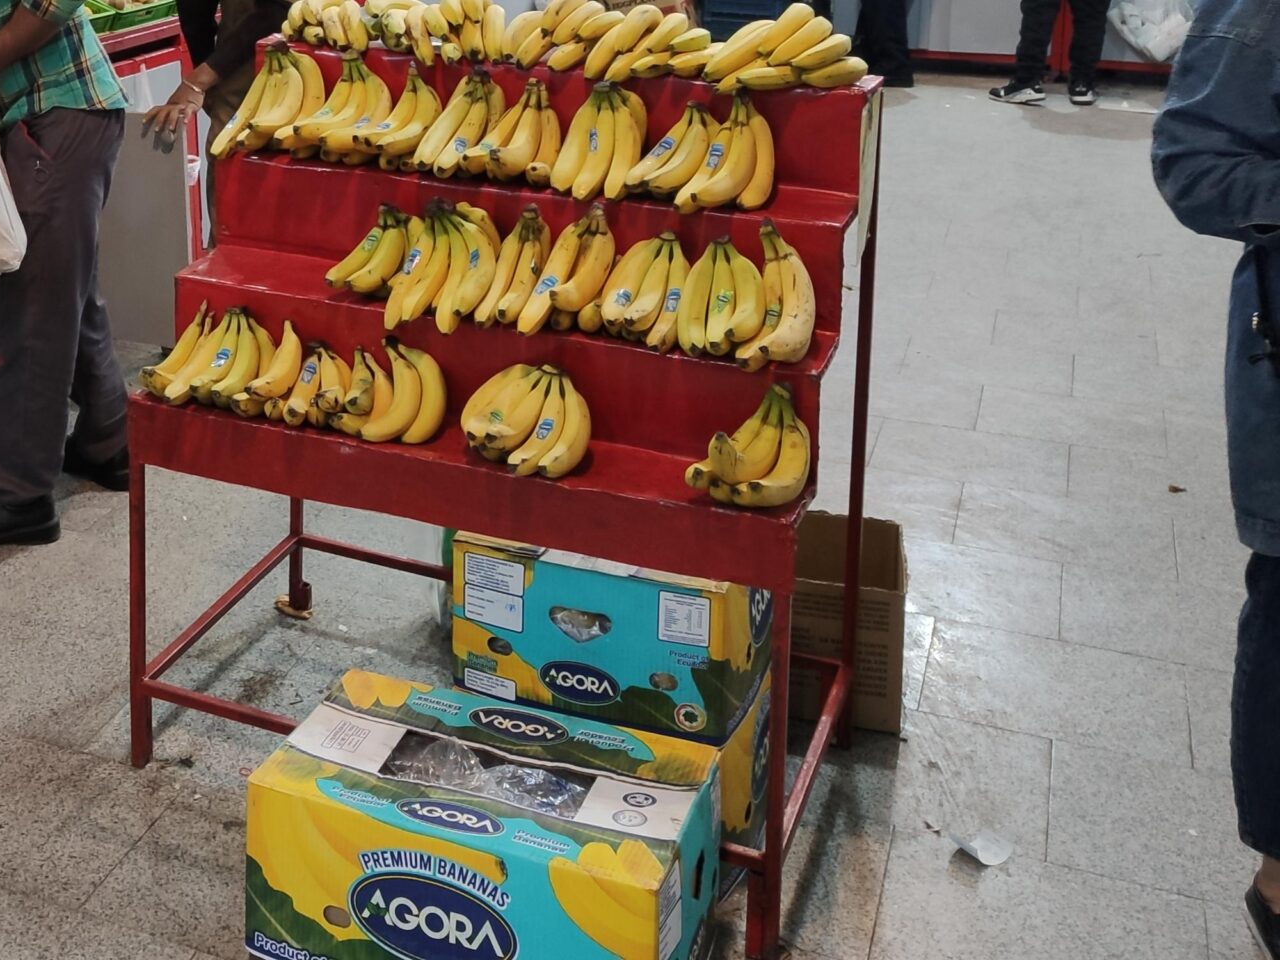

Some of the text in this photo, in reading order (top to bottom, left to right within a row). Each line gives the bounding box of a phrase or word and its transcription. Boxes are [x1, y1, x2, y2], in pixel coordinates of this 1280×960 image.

[546, 668, 614, 697] AGORA
[479, 711, 563, 740] AGORA
[579, 730, 625, 744] Ecuador
[591, 740, 635, 752] Product
[403, 803, 494, 833] AGORA
[512, 835, 567, 854] Bananas
[516, 829, 570, 849] Premium
[361, 852, 510, 908] PREMIUM BANANAS
[362, 888, 505, 958] AGORA
[254, 932, 310, 960] Product
